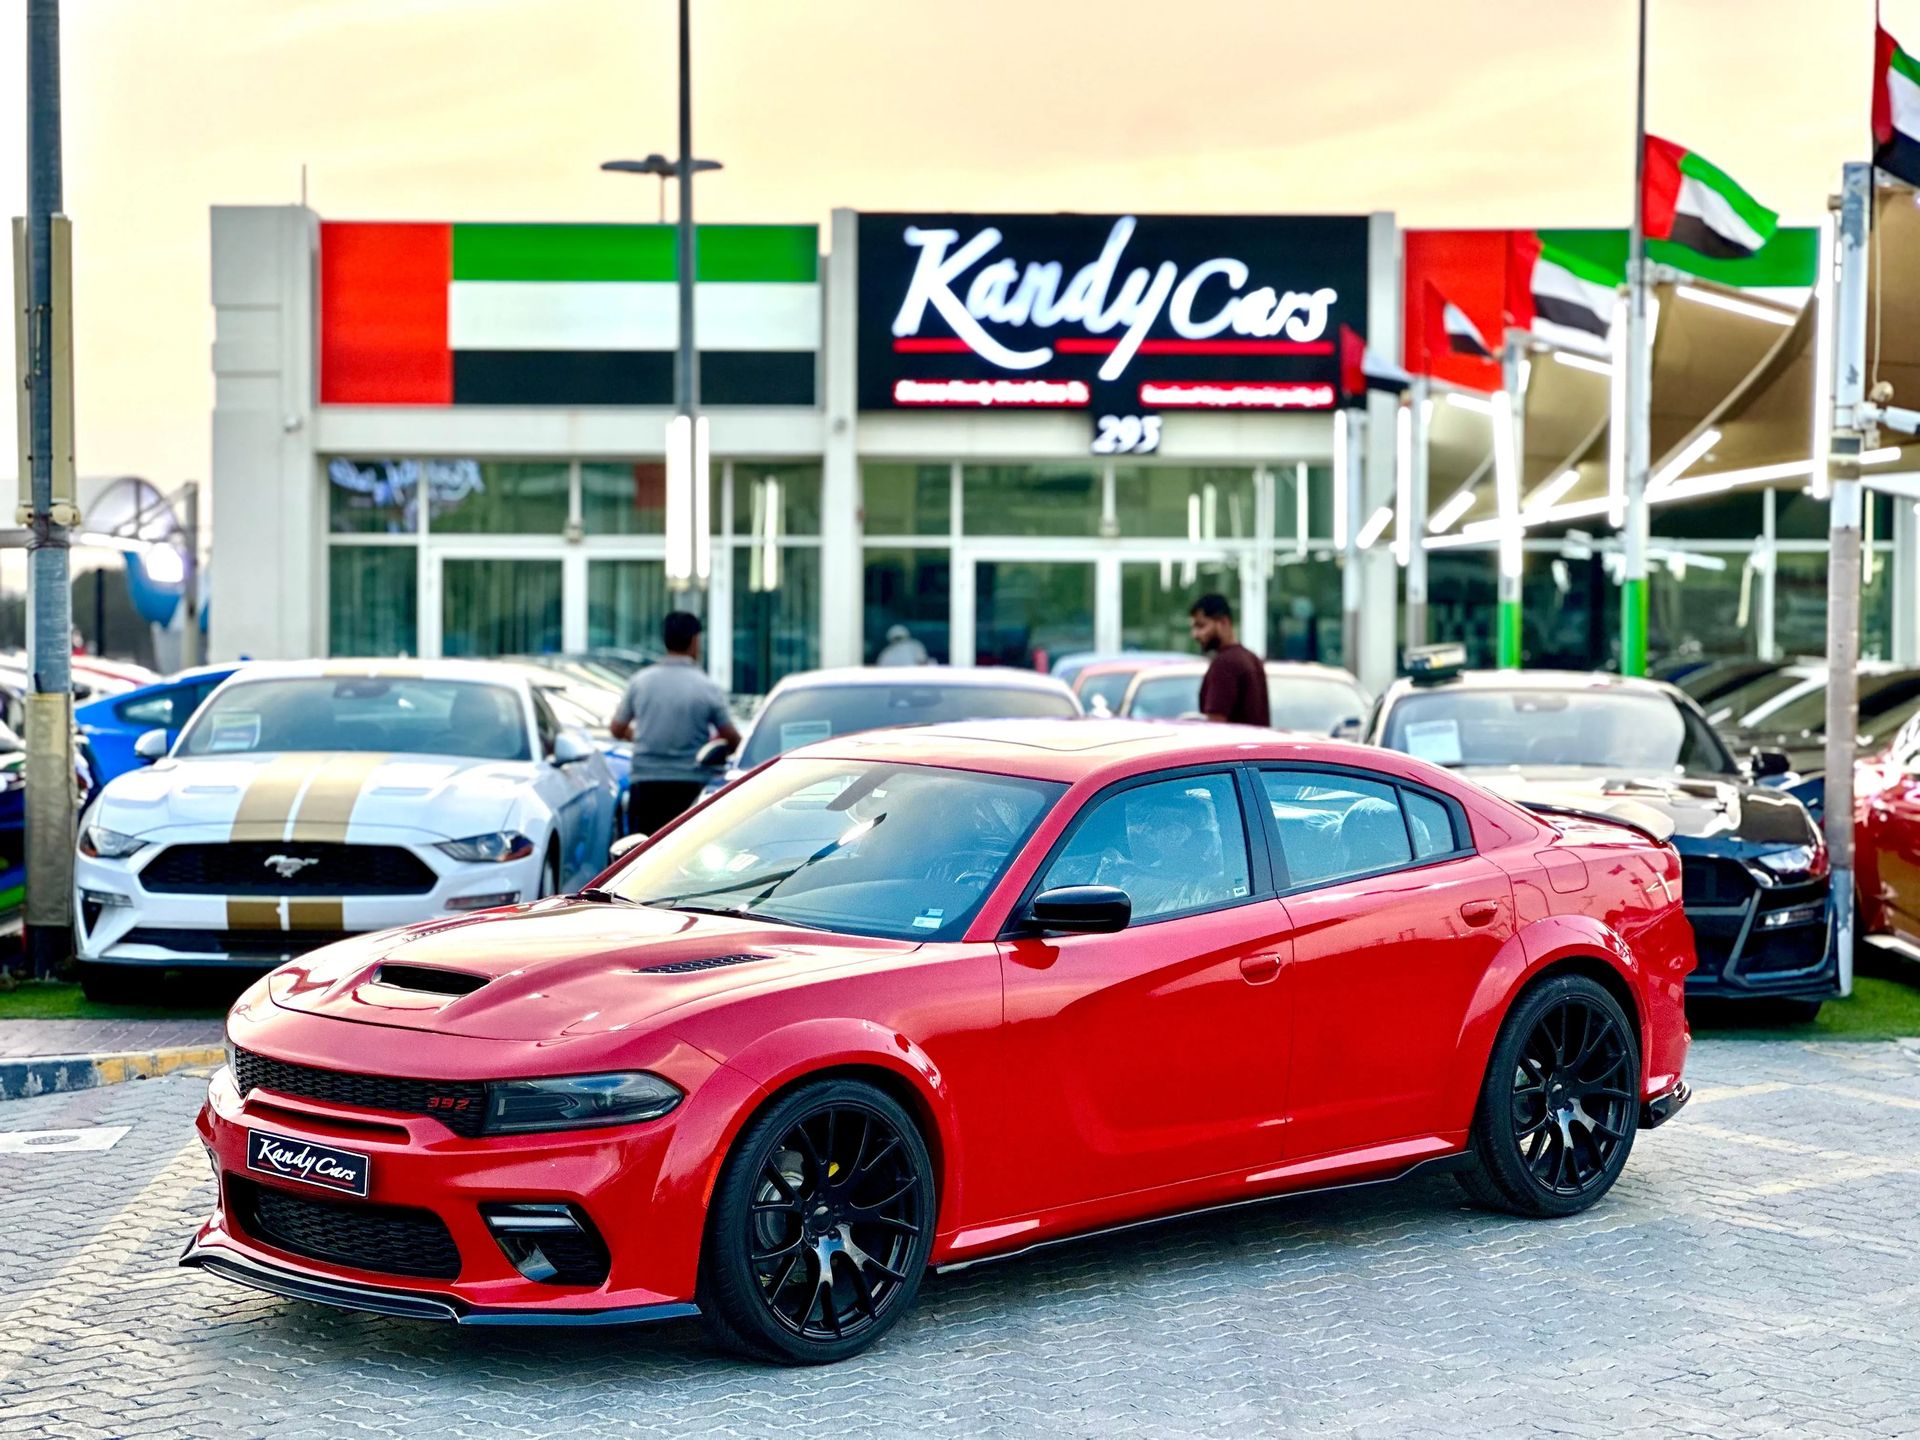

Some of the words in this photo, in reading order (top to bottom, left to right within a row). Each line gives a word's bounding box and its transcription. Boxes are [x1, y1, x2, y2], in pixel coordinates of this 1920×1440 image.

[891, 216, 1177, 381] Kandy
[1169, 258, 1337, 341] Cars
[1091, 415, 1162, 453] 295
[427, 1096, 470, 1111] 392
[258, 1138, 316, 1178] Kandy
[315, 1158, 356, 1180] Cars
